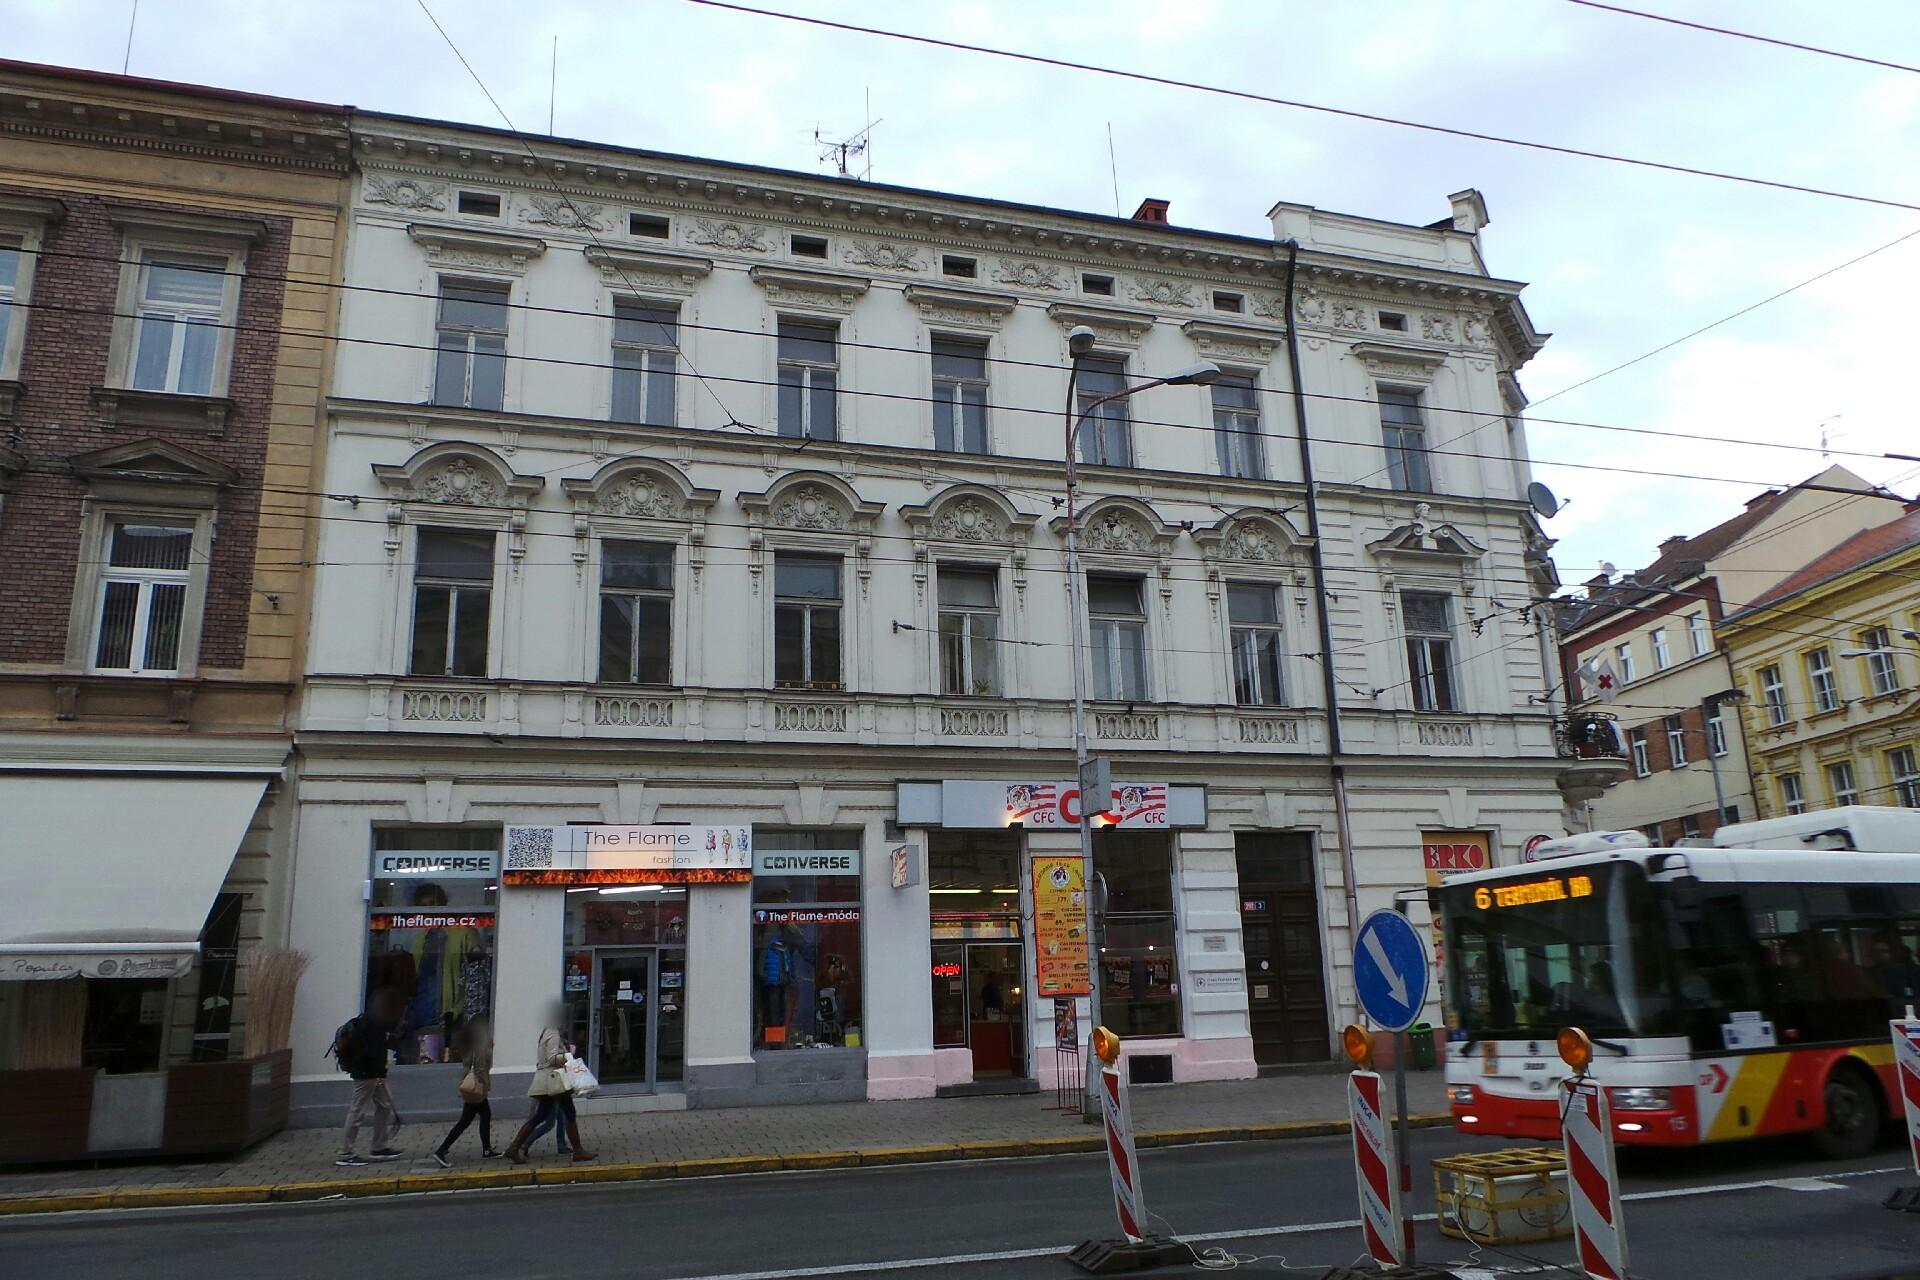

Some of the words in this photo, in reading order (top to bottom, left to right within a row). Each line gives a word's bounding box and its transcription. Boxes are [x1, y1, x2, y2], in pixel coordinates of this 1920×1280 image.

[1033, 812, 1055, 823] CFC
[1144, 812, 1165, 823] CFC
[584, 831, 620, 845] The
[628, 831, 690, 845] Flame
[383, 857, 490, 871] CONVERSE
[653, 855, 691, 864] fashion
[763, 856, 850, 869] CONVERSE
[1475, 887, 1492, 910] 6
[392, 915, 476, 927] theflame.cz
[769, 911, 789, 922] The
[791, 909, 859, 921] Flame-móda
[932, 964, 960, 977] OPEN
